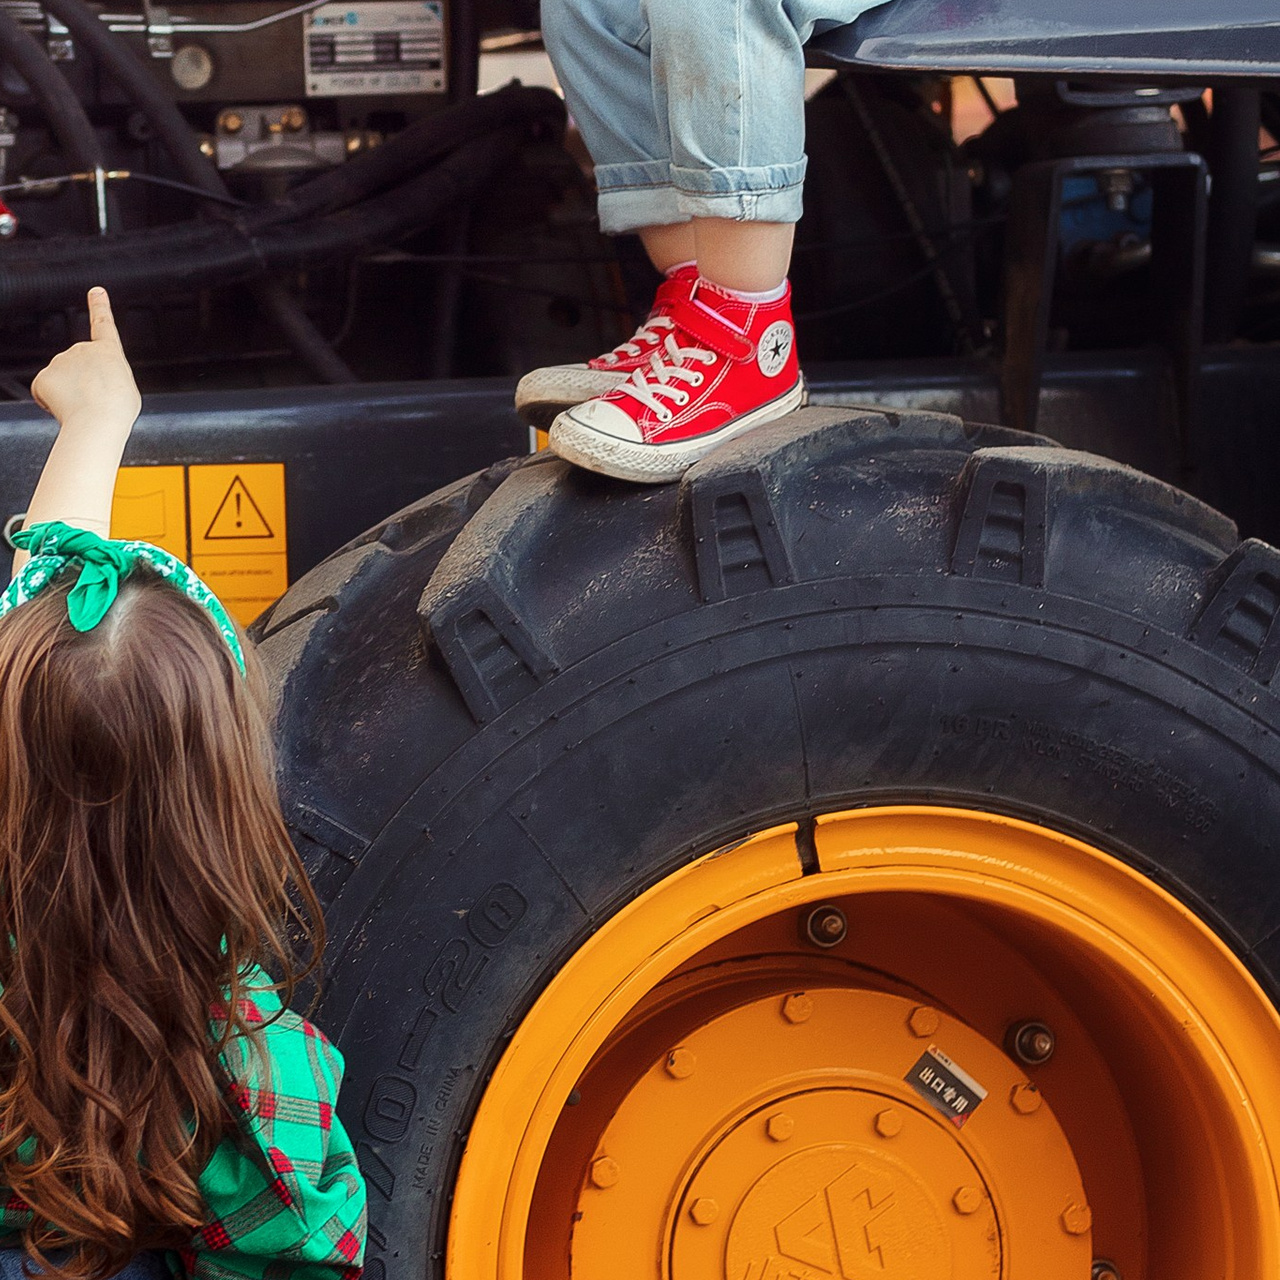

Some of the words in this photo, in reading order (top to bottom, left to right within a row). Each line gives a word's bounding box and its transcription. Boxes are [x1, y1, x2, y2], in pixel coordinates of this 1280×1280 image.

[939, 713, 969, 734] 16
[975, 716, 1011, 741] PR
[1022, 736, 1061, 759] NYLON
[1076, 753, 1145, 793] STANDARD
[412, 1143, 434, 1189] MADE
[426, 1118, 441, 1137] IN
[434, 1066, 462, 1112] CHINA
